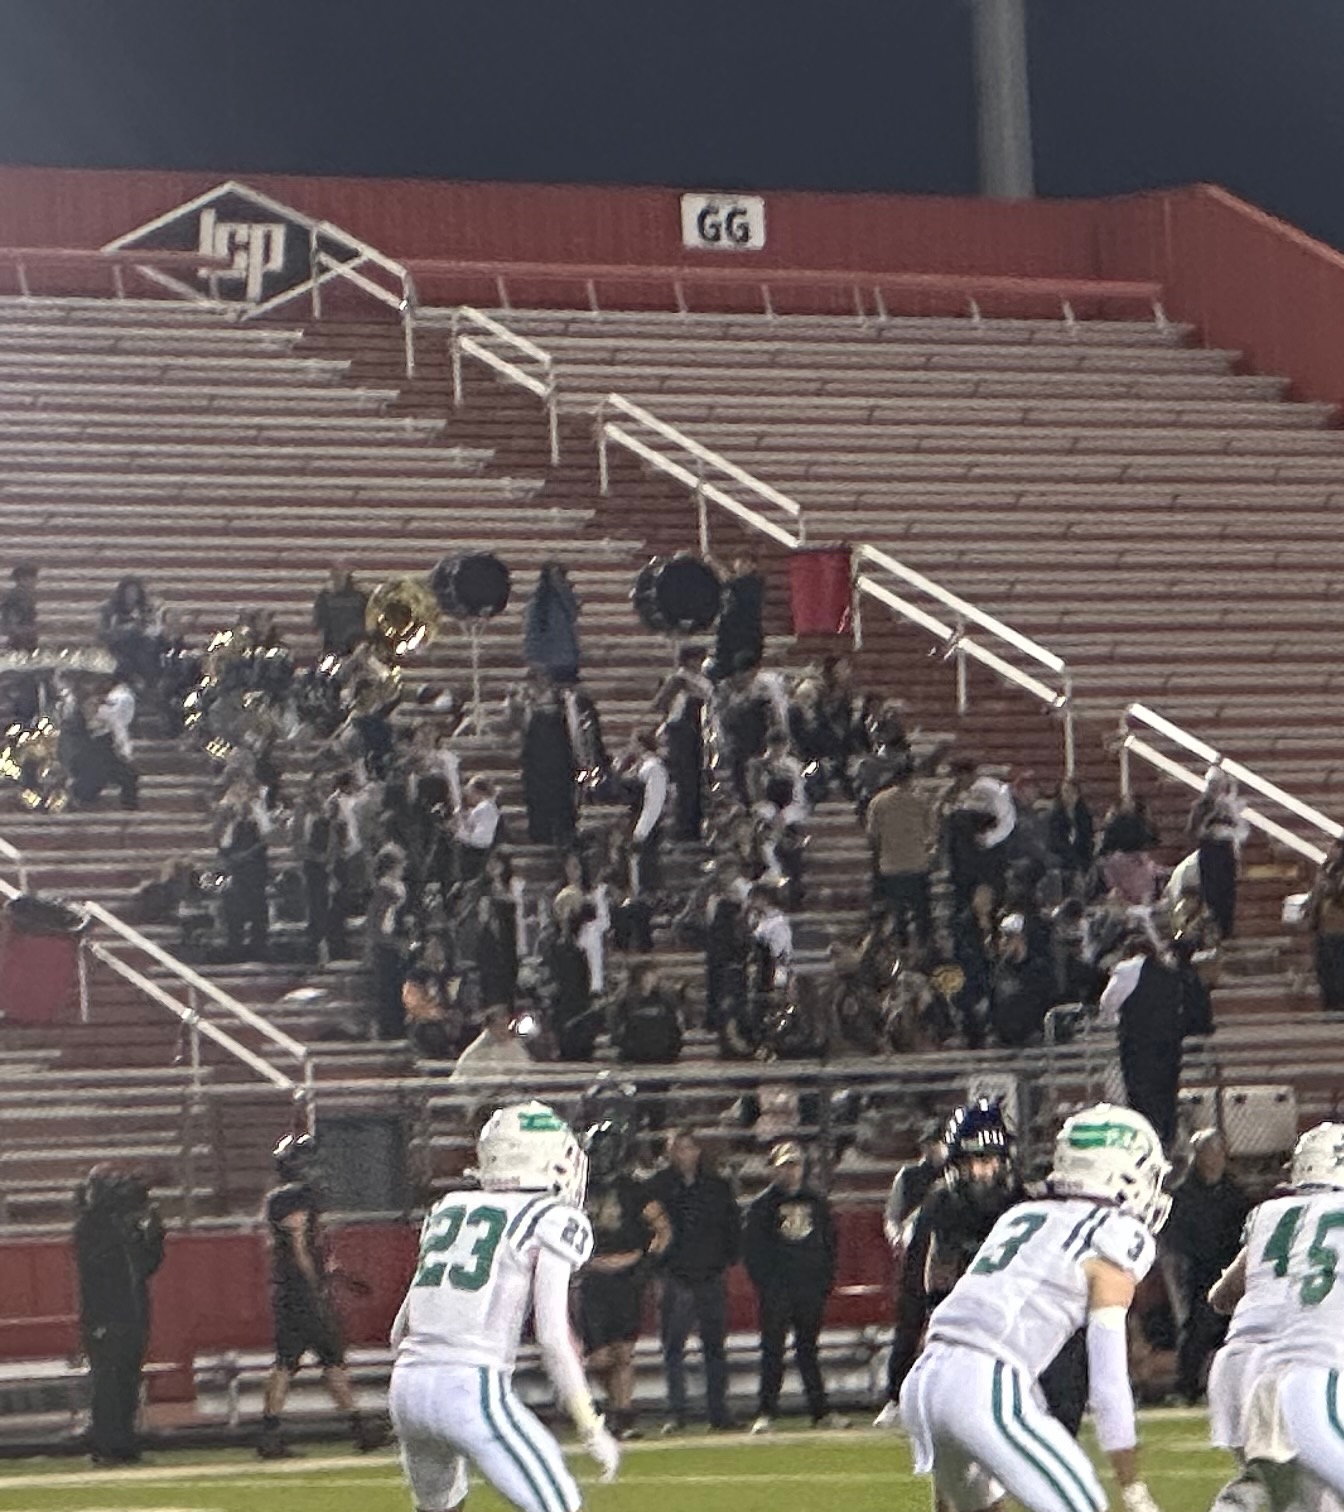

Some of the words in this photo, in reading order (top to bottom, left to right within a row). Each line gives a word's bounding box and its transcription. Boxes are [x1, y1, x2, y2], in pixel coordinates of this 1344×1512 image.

[697, 204, 751, 243] GG
[414, 1204, 508, 1291] 23
[969, 1211, 1048, 1276] 3
